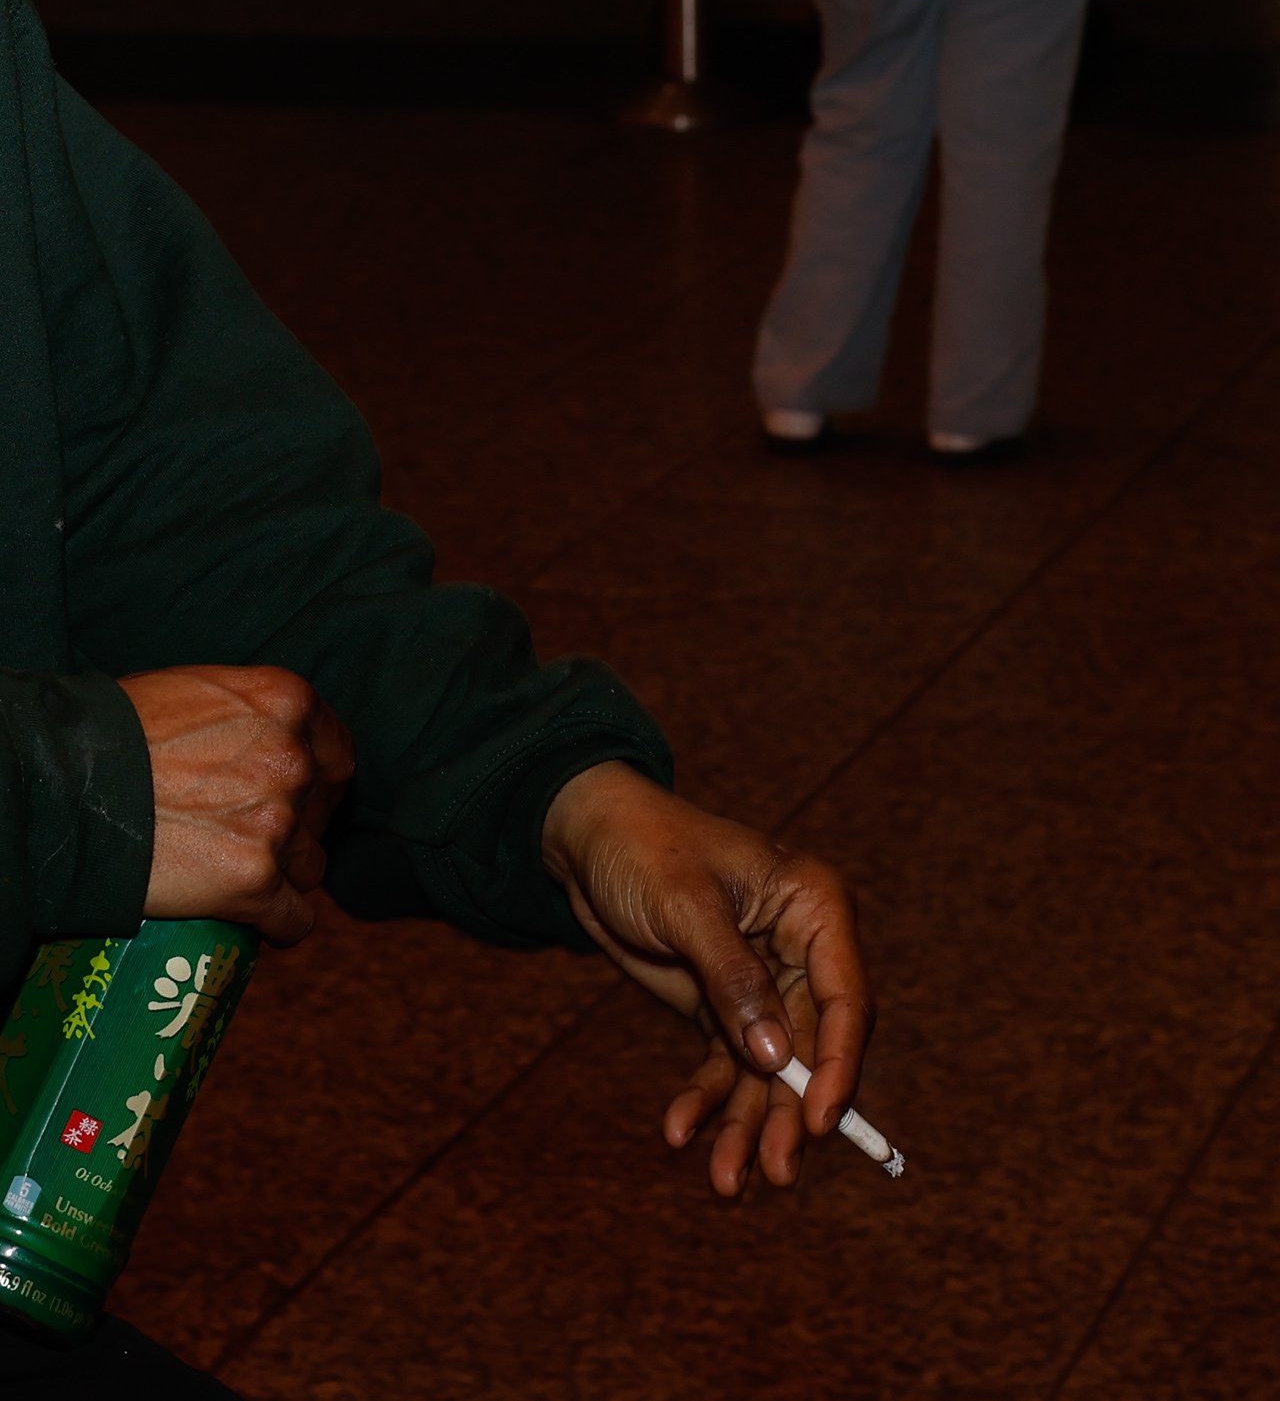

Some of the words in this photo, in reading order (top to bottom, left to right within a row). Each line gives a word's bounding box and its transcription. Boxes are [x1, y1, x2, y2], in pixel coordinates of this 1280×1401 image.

[75, 1167, 92, 1182] Oi
[19, 1182, 32, 1198] 5
[40, 1213, 77, 1241] Bold
[21, 1280, 33, 1297] fl
[33, 1289, 48, 1306] oz
